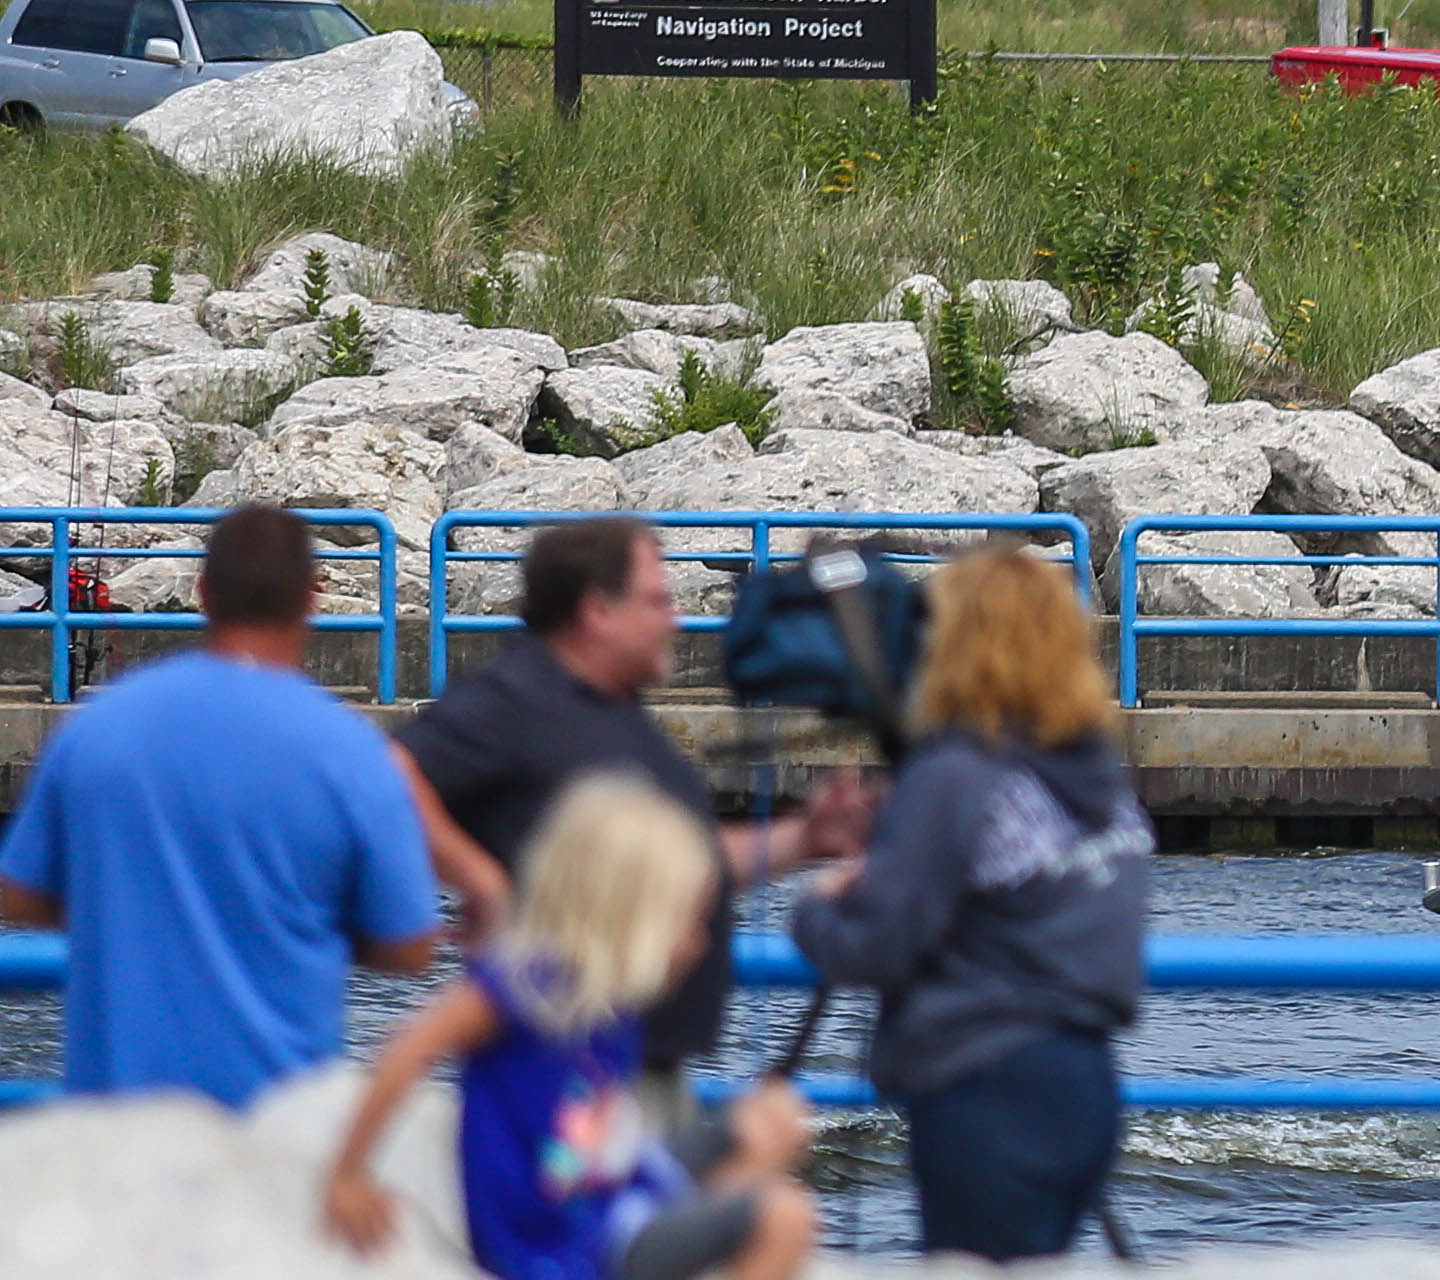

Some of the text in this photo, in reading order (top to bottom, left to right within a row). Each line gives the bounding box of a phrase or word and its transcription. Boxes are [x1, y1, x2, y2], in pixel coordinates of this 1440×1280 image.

[656, 16, 864, 40] Navigation Project
[656, 55, 728, 69] Cooperating
[731, 57, 758, 67] with
[761, 57, 780, 67] the
[833, 58, 886, 70] Michigan
